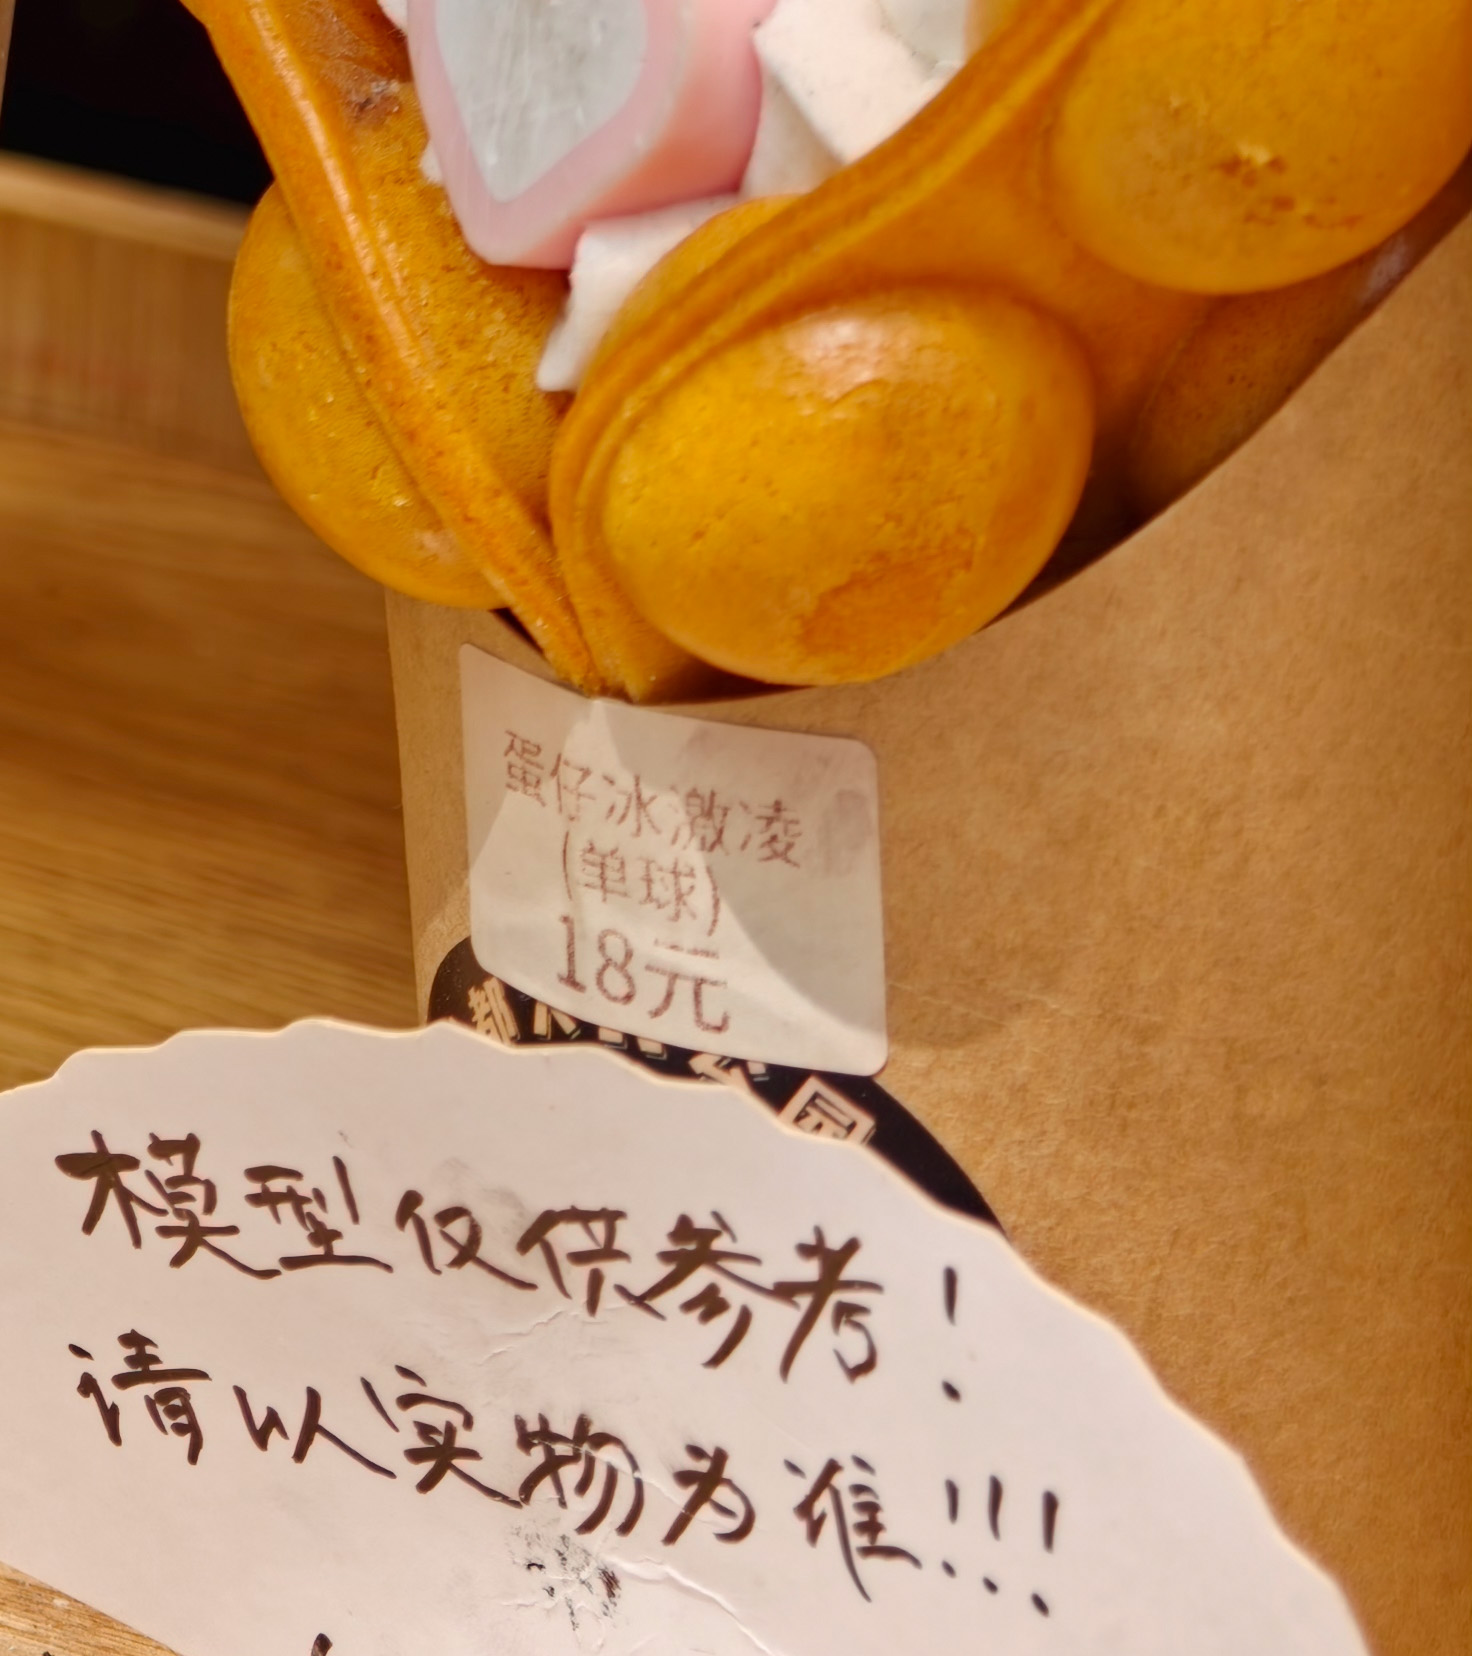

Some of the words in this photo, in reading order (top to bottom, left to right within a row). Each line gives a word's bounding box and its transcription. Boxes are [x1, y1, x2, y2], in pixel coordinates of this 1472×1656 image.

[503, 730, 803, 870] 蛋仔冰激凌
[557, 914, 732, 1035] 18元
